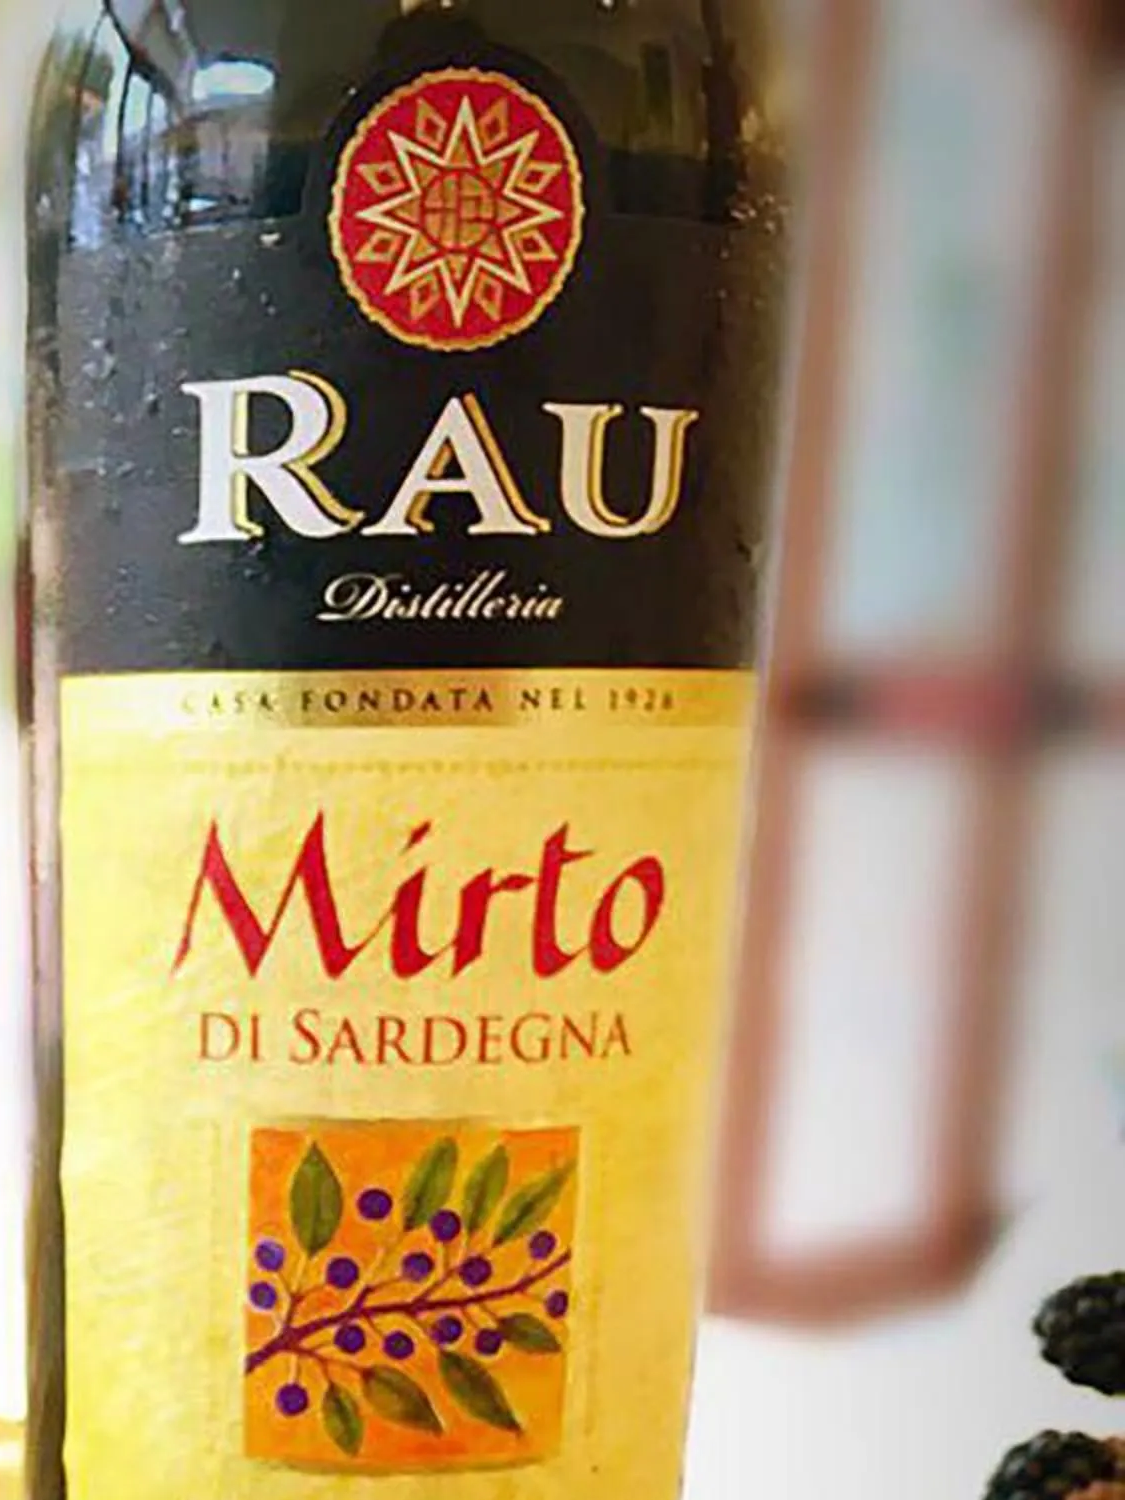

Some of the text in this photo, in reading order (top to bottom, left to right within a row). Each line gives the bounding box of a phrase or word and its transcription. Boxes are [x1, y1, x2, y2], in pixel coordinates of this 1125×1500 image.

[179, 369, 698, 543] RAU
[317, 570, 564, 622] Distilleria
[181, 689, 275, 713] CASA
[300, 688, 494, 713] FONDATA
[519, 687, 587, 712] NEL
[172, 808, 665, 980] Mirto
[199, 1008, 632, 1065] DI SARDEGNA
